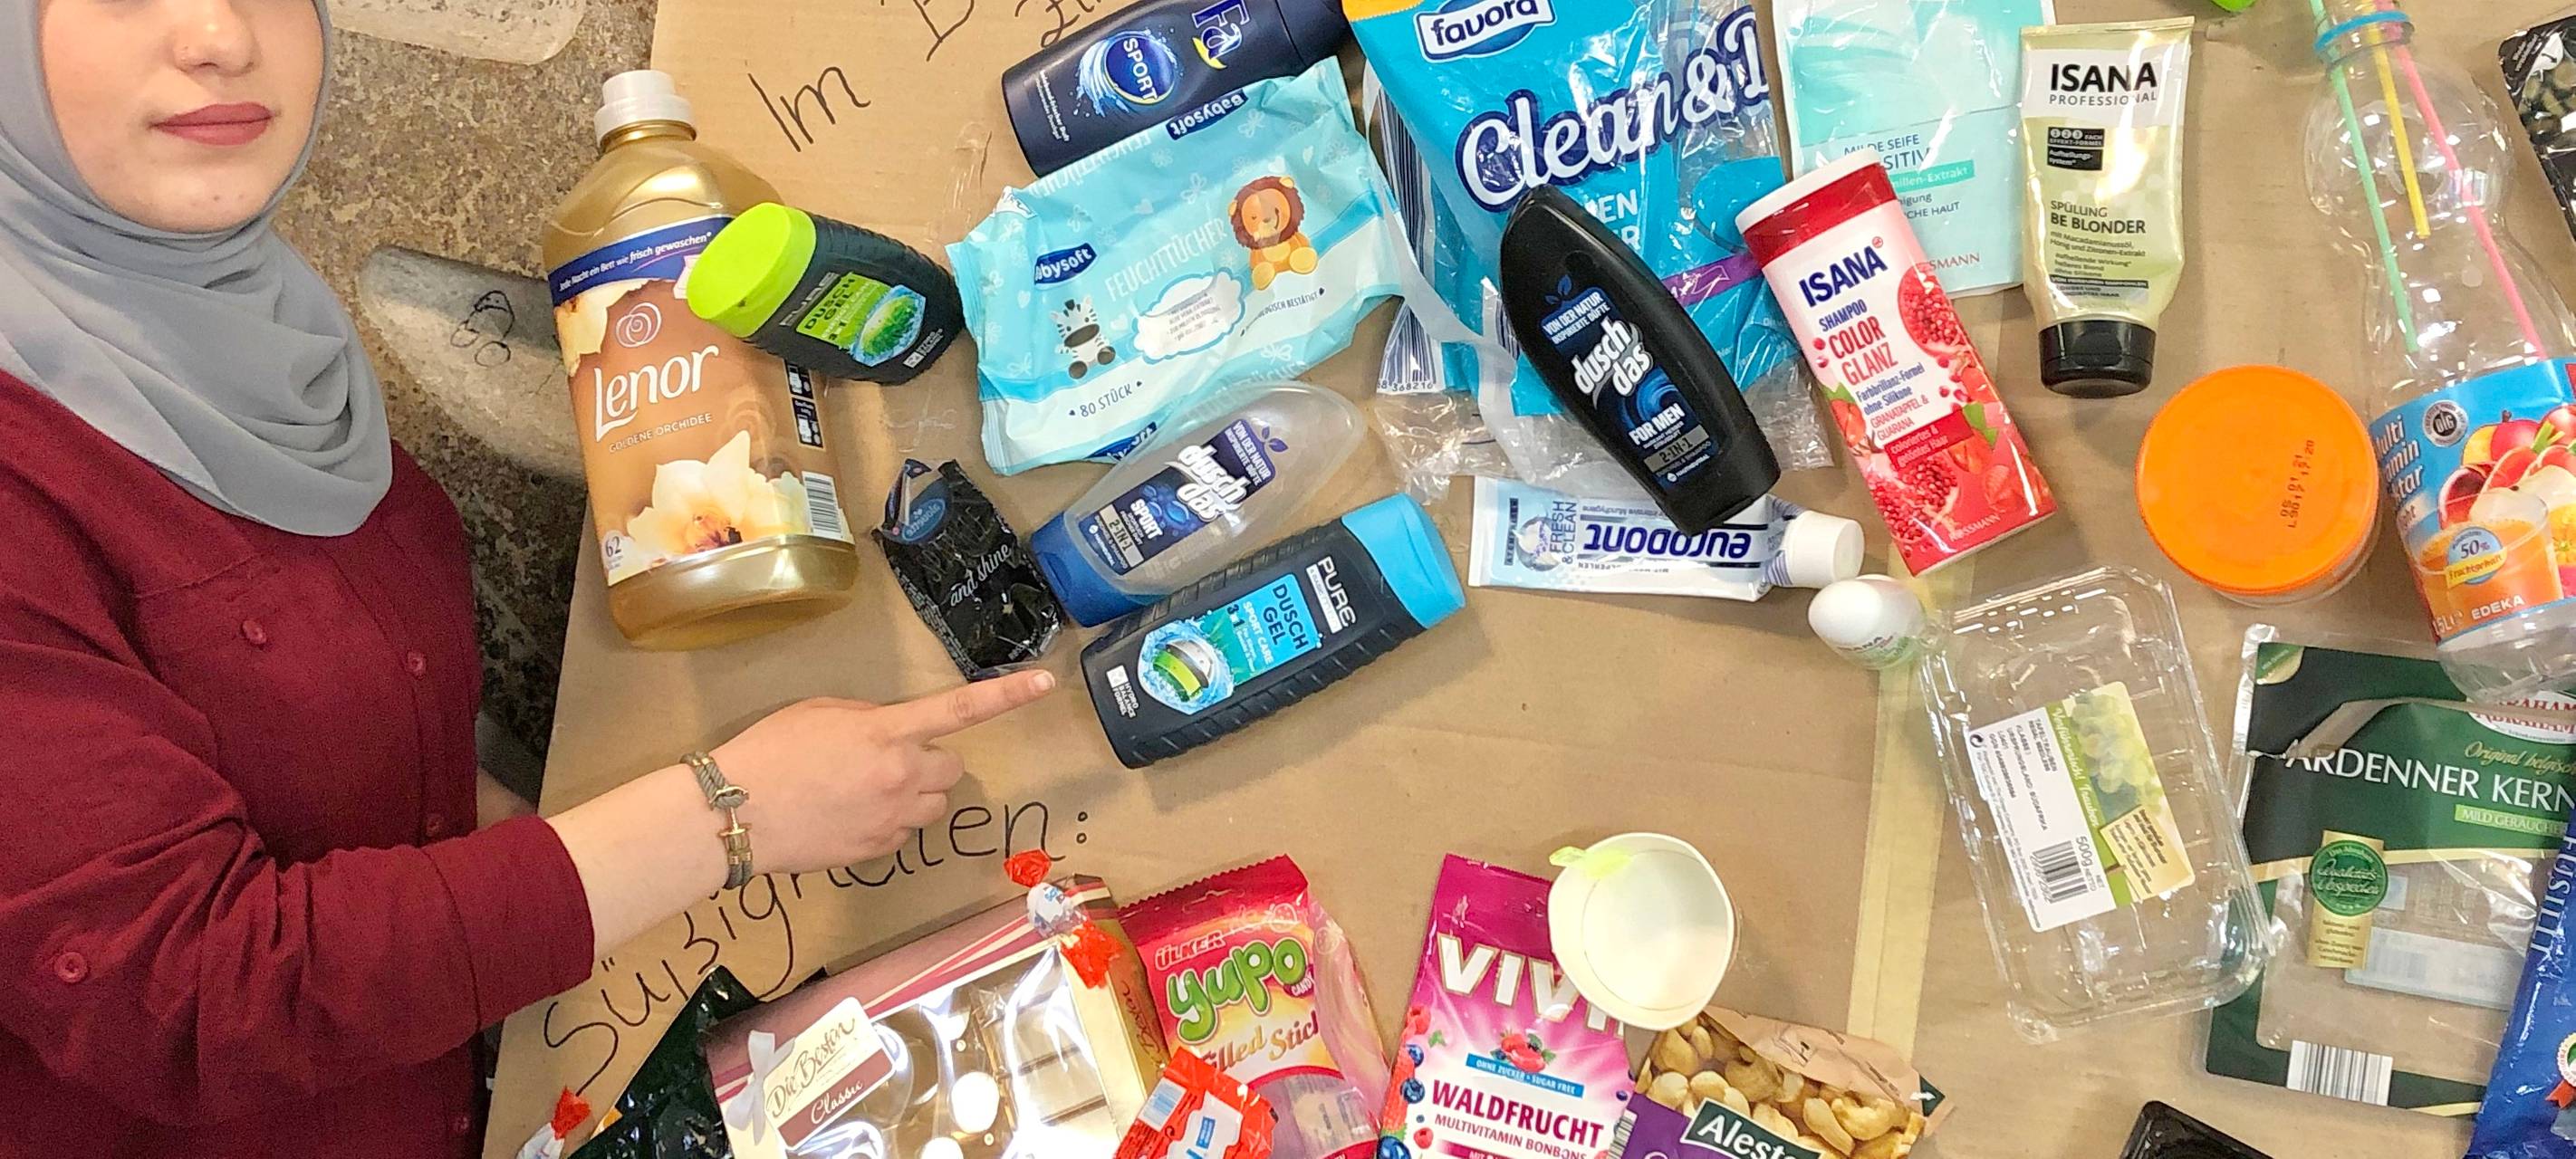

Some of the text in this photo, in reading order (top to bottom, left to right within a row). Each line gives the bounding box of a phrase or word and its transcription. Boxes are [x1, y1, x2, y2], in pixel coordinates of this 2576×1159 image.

[1430, 0, 1539, 45] favora
[1121, 36, 1159, 102] SPORT
[2051, 62, 2158, 92] ISANA
[747, 66, 870, 154] Im
[1168, 91, 1248, 139] Babysoft
[1461, 72, 1678, 206] Clean
[1887, 134, 1920, 152] SEIFE
[1932, 201, 1960, 216] HAUT
[2051, 200, 2108, 217] SPÜLUNG
[2051, 212, 2146, 234] BE BLONDER
[630, 247, 653, 264] frisch
[1105, 217, 1227, 302] FEUCHTTÜCHER
[1800, 245, 1888, 307] ISANA
[803, 274, 857, 332] DUSCH
[822, 287, 855, 322] GEL
[1542, 291, 1604, 338] VON DER NATUR
[1586, 301, 1611, 322] DÜFTE
[1819, 300, 1867, 331] SHAMPOO
[1572, 316, 1631, 395] dusch
[1828, 316, 1885, 359] COLOR
[1610, 343, 1654, 397] das
[1842, 343, 1898, 385] GLANZ
[594, 345, 719, 443] Lenor
[1080, 383, 1133, 417] 80 STÜCK
[1862, 398, 1884, 416] ohne
[609, 412, 713, 453] GOLDENE ORCHIDEE
[1628, 401, 1687, 446] FOR MEN
[1231, 420, 1272, 481] VON DER NATUR
[1658, 436, 1695, 464] 2-IN-1
[1178, 445, 1252, 511] dusch
[1130, 499, 1163, 540] SPORT
[1177, 482, 1224, 523] das
[604, 536, 622, 558] 62
[1108, 518, 1134, 551] 2-IN-1
[1551, 500, 1562, 553] FRESH
[1562, 502, 1576, 554] CLEAN
[2460, 540, 2491, 560] 50%
[950, 568, 979, 607] and
[976, 543, 1013, 582] shine
[1317, 556, 1356, 627] PURE
[1263, 607, 1286, 646] GEL
[1273, 582, 1310, 650] DUSCH
[2472, 595, 2524, 620] EDEKA
[1242, 600, 1275, 665] SPORT CARE
[2465, 741, 2527, 766] Original
[2463, 809, 2493, 823] MILD
[2071, 835, 2097, 868] 500g
[1155, 931, 1226, 972] ÜLKER
[1167, 938, 1308, 1045] yupo
[766, 1078, 806, 1119] Die
[791, 1018, 856, 1090] Besten
[1475, 1059, 1576, 1095] OHNE ZUCKER SUGAR FREE
[810, 1078, 863, 1125] Classic
[1432, 1079, 1604, 1149] WALDFRUCHT
[1435, 1113, 1523, 1148] MULTIVITAMIN
